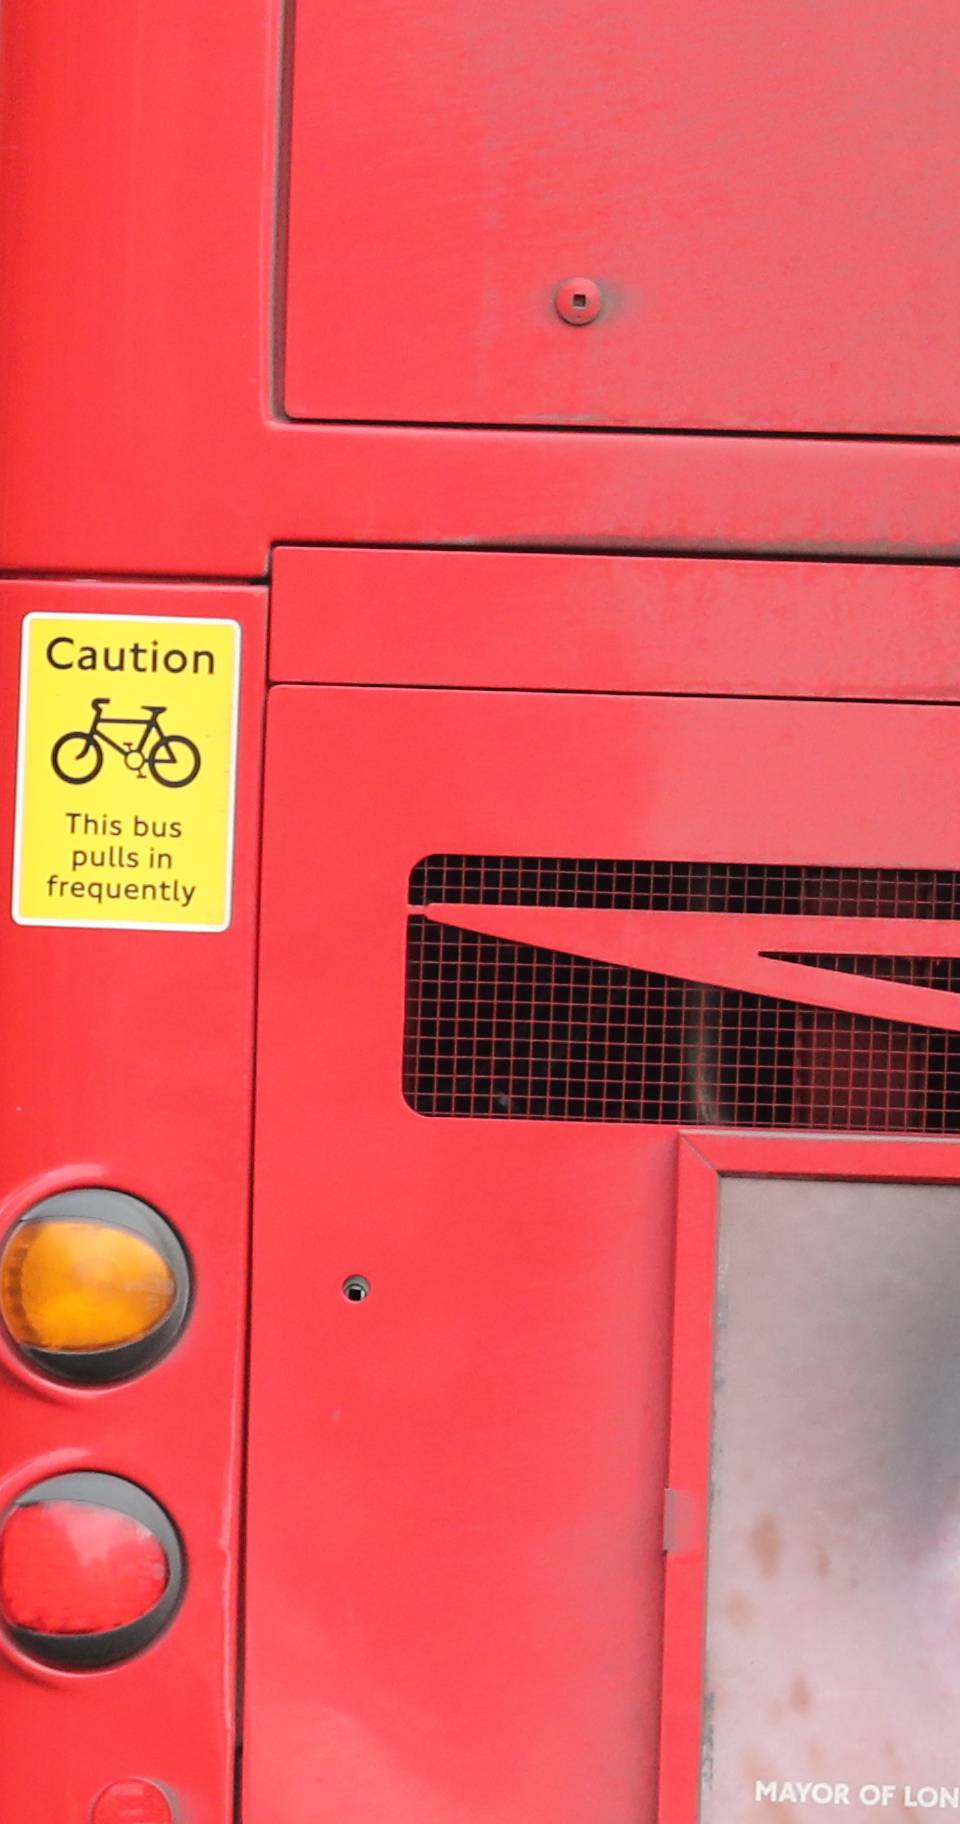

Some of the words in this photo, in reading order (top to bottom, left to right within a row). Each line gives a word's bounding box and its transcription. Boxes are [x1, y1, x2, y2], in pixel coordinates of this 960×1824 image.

[46, 636, 216, 675] Caution
[65, 812, 122, 836] This
[134, 815, 182, 838] bus
[72, 846, 139, 872] pulls
[149, 847, 172, 869] in
[47, 874, 196, 907] frequently
[755, 1780, 850, 1805] MAYOR
[859, 1784, 896, 1806] OF
[904, 1786, 960, 1809] LON
